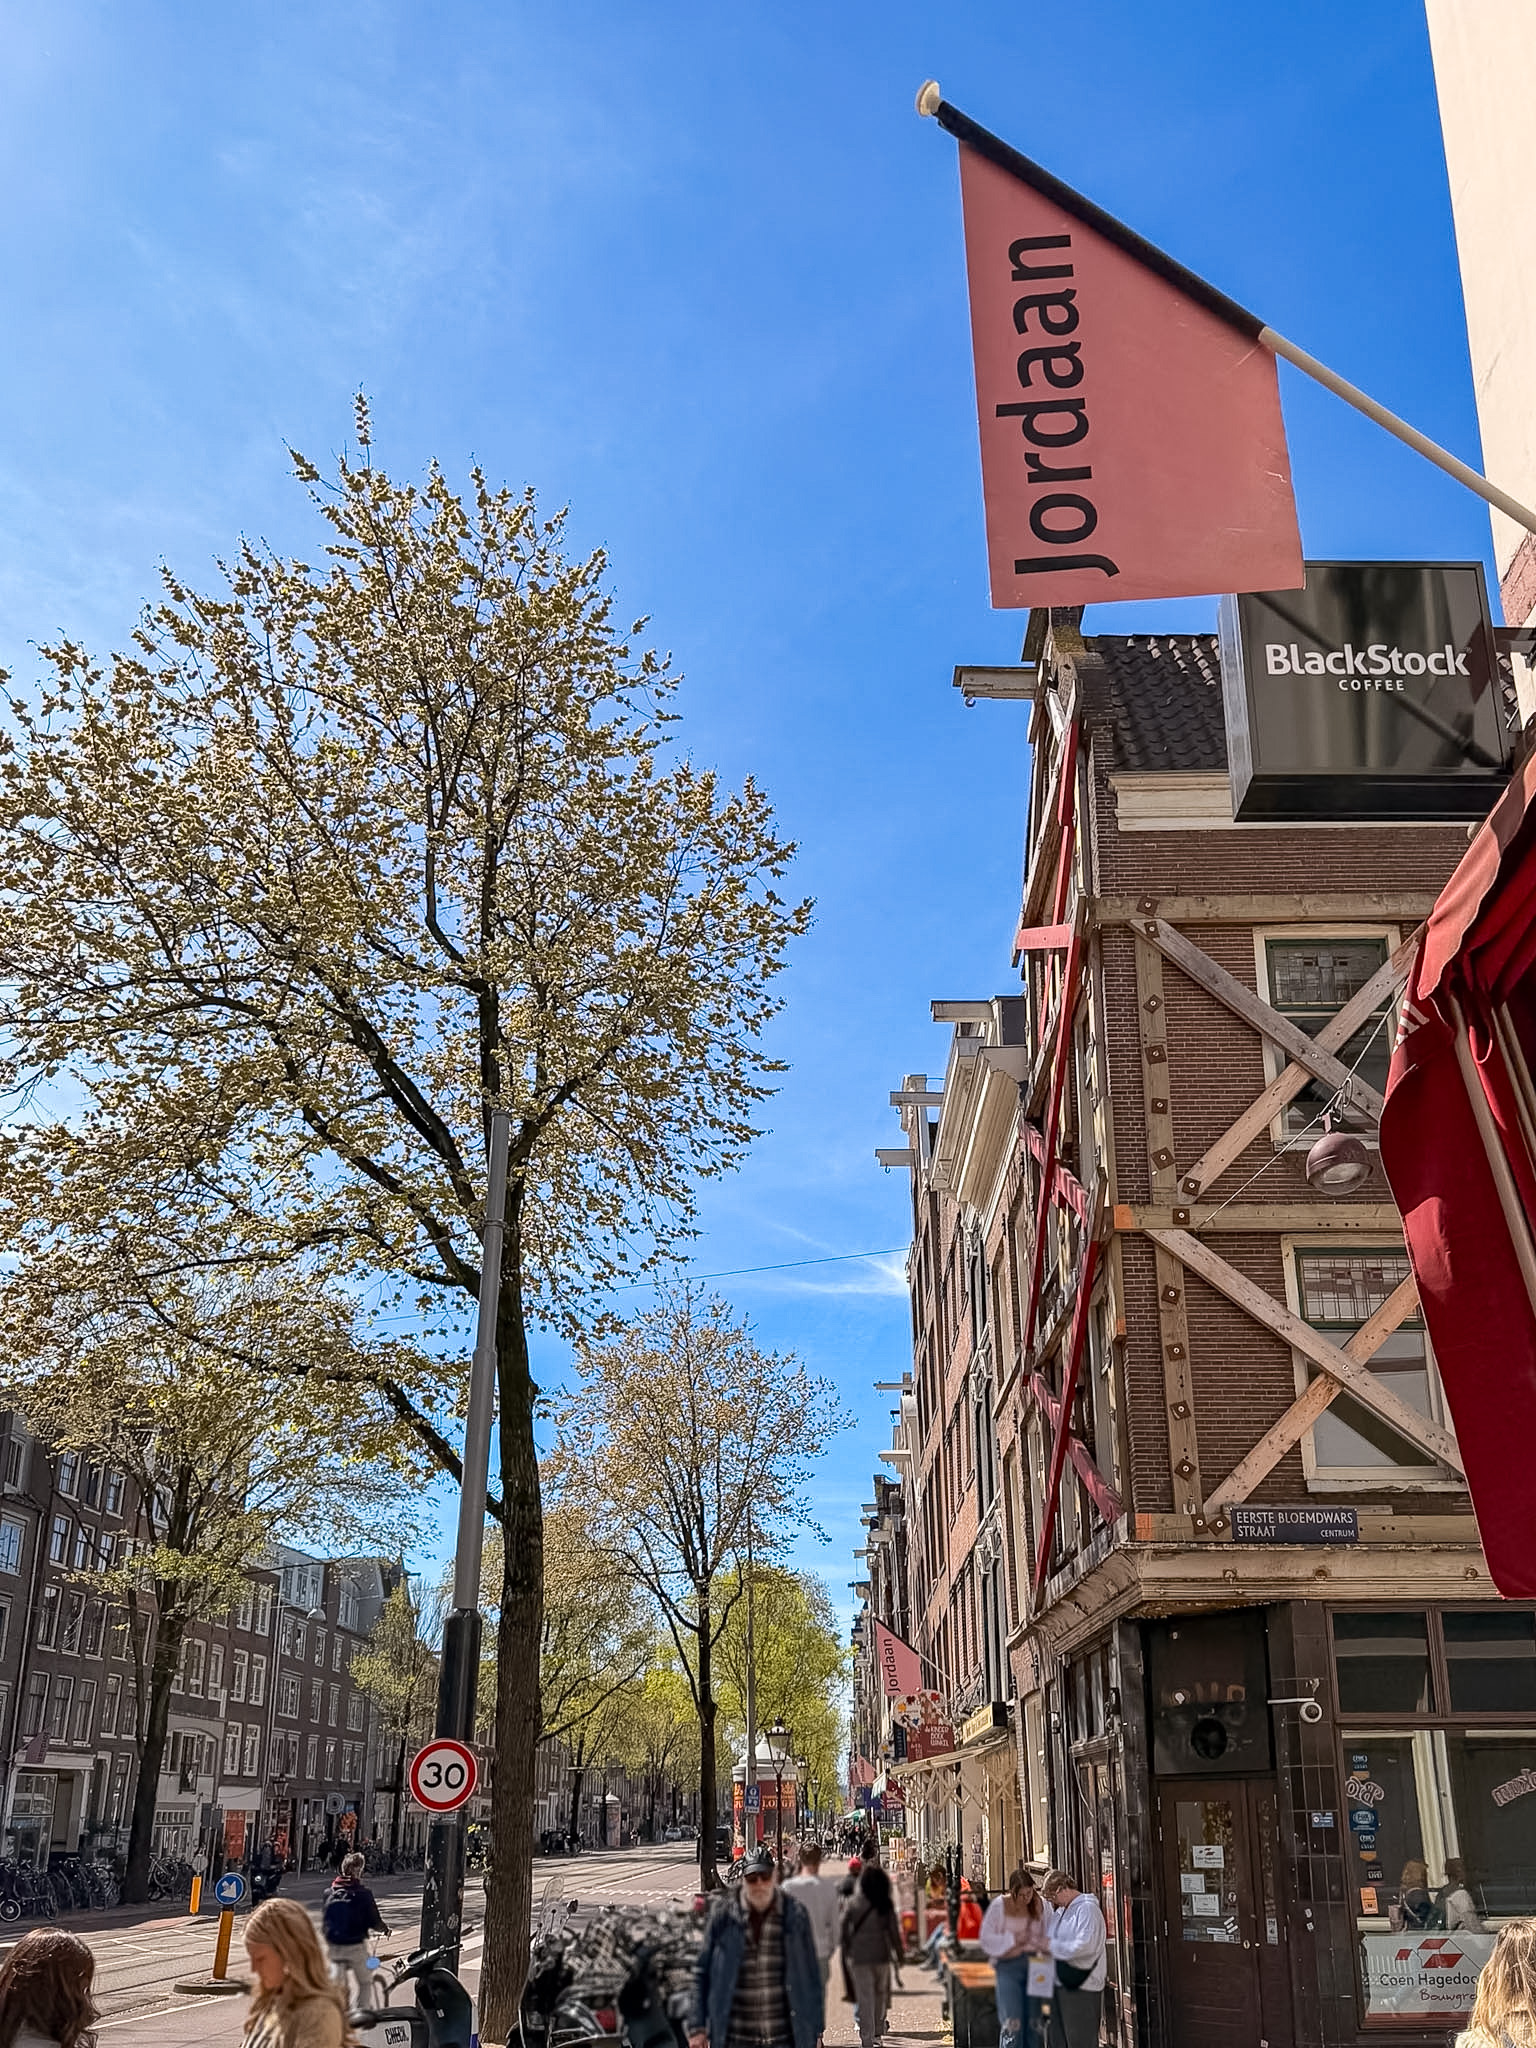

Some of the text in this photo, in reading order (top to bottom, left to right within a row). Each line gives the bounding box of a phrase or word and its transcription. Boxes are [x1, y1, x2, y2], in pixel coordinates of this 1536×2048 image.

[995, 233, 1121, 578] Jordaan
[1264, 643, 1471, 676] BlackStock
[1338, 679, 1405, 692] COFFEE
[1236, 1511, 1354, 1524] EERSTE BLOEMDWARS
[1238, 1525, 1276, 1537] STRAAT
[1320, 1529, 1355, 1538] CENTRUM
[883, 1638, 901, 1692] Jordaan
[422, 1762, 465, 1790] 30
[1379, 1973, 1415, 1986] Coen
